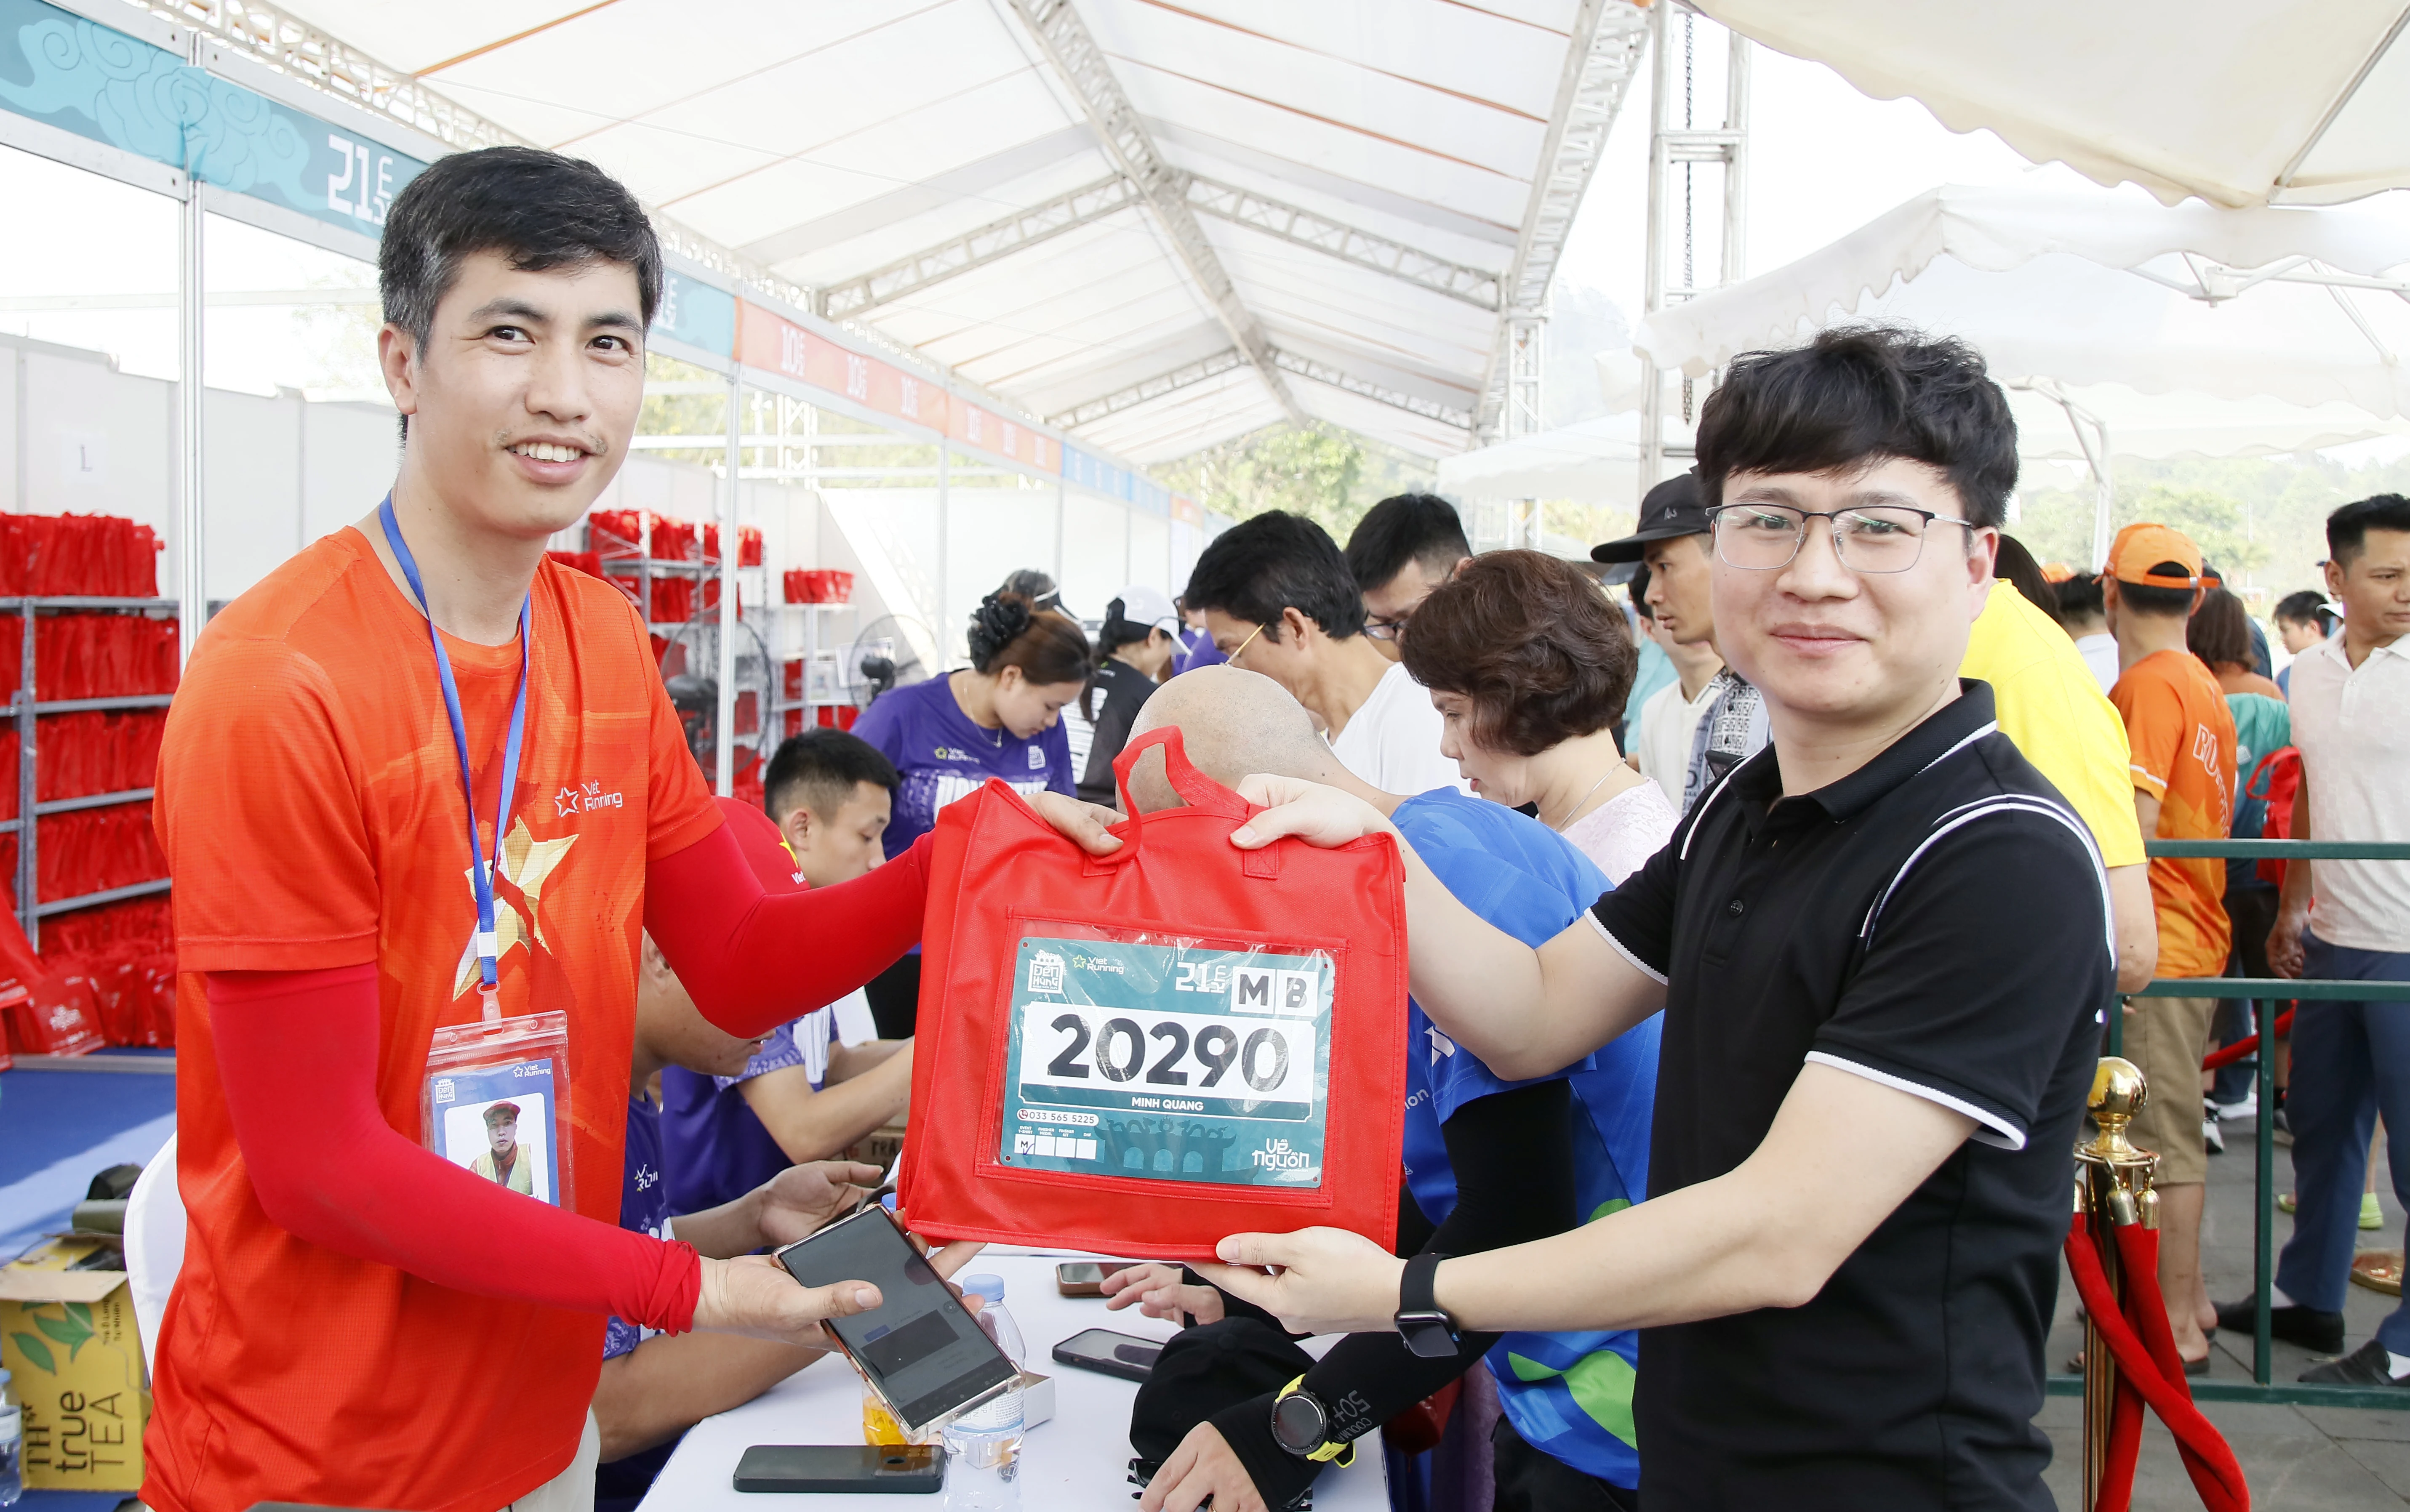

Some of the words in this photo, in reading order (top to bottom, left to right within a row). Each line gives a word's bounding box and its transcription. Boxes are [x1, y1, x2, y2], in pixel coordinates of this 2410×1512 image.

[328, 133, 373, 223] 21
[1087, 963, 1125, 974] Running
[1088, 956, 1108, 965] Viet
[1175, 962, 1210, 993] 21
[1238, 974, 1269, 1006] M
[1285, 977, 1307, 1008] B
[1047, 1013, 1289, 1092] 20290
[524, 1067, 551, 1077] Running
[1072, 1115, 1095, 1123] 5225
[1131, 1097, 1160, 1109] MINH
[1162, 1099, 1204, 1112] QUANG
[1333, 1390, 1371, 1422] 50+
[55, 1390, 87, 1473] true
[89, 1392, 125, 1474] TEA
[1334, 1418, 1372, 1443] COOLMA
[27, 1426, 51, 1474] TH
